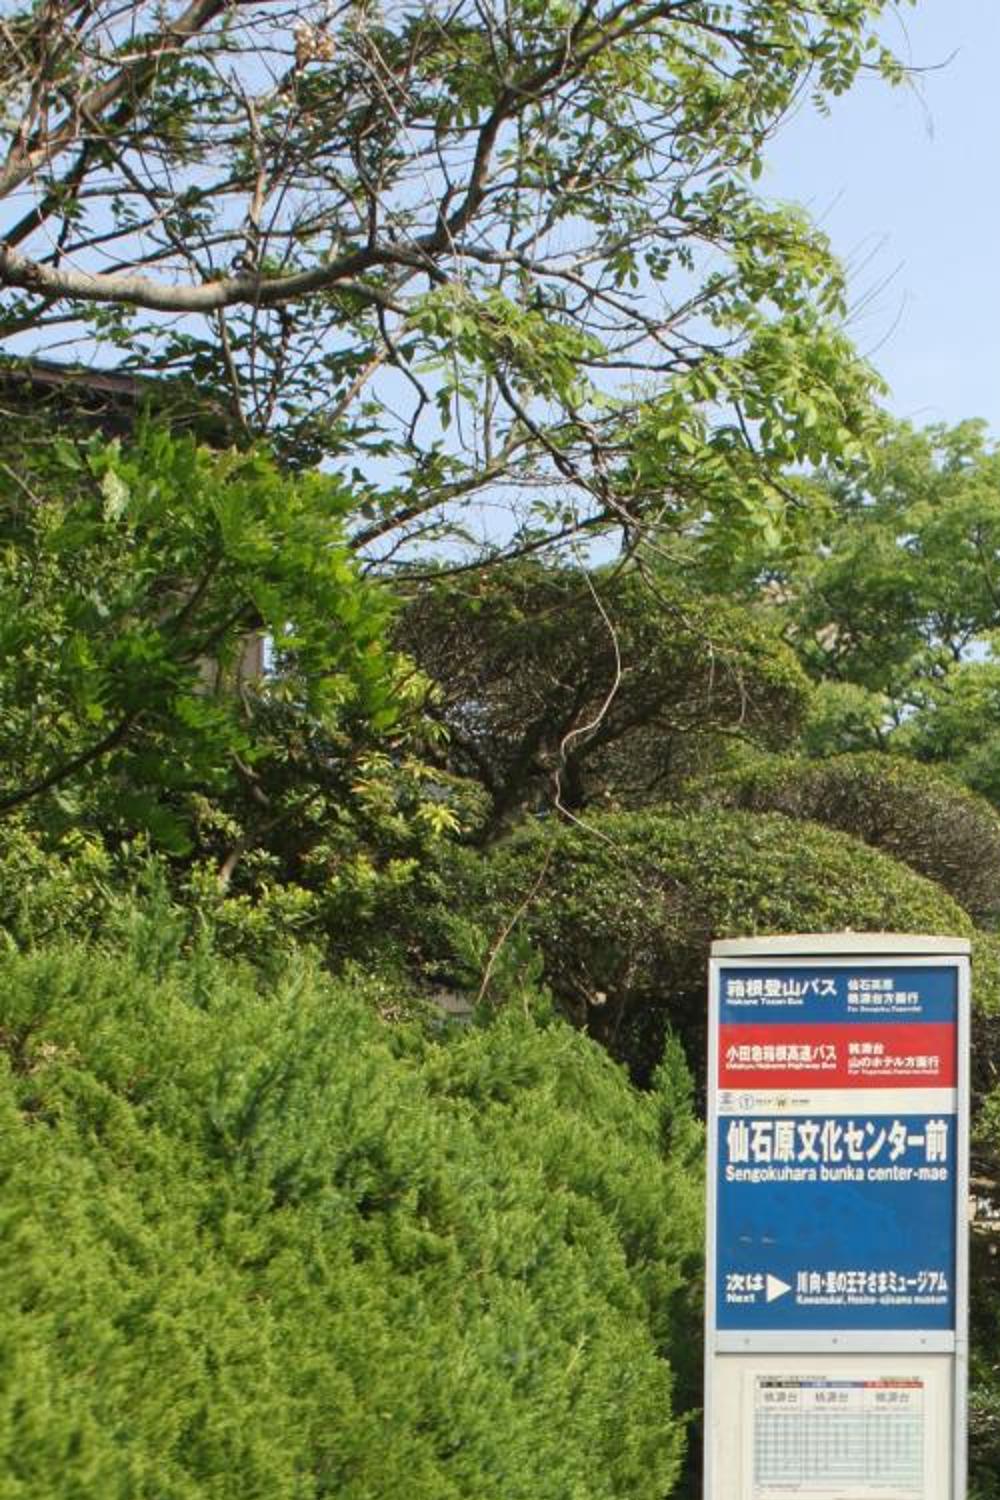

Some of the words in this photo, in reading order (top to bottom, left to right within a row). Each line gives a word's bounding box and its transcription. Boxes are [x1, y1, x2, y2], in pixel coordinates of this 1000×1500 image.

[727, 978, 837, 997] 箱根登山バス
[726, 1045, 837, 1062] 小田急箱根高速バス
[727, 1119, 949, 1163] 仙石原文化センター前
[725, 1165, 817, 1183] Sengokuhara
[820, 1164, 865, 1181] bunka
[867, 1165, 948, 1181] center-mae
[726, 1273, 765, 1292] 次は
[796, 1271, 948, 1294] 川向・星の王子さまミュージアム
[727, 1294, 756, 1304] Next
